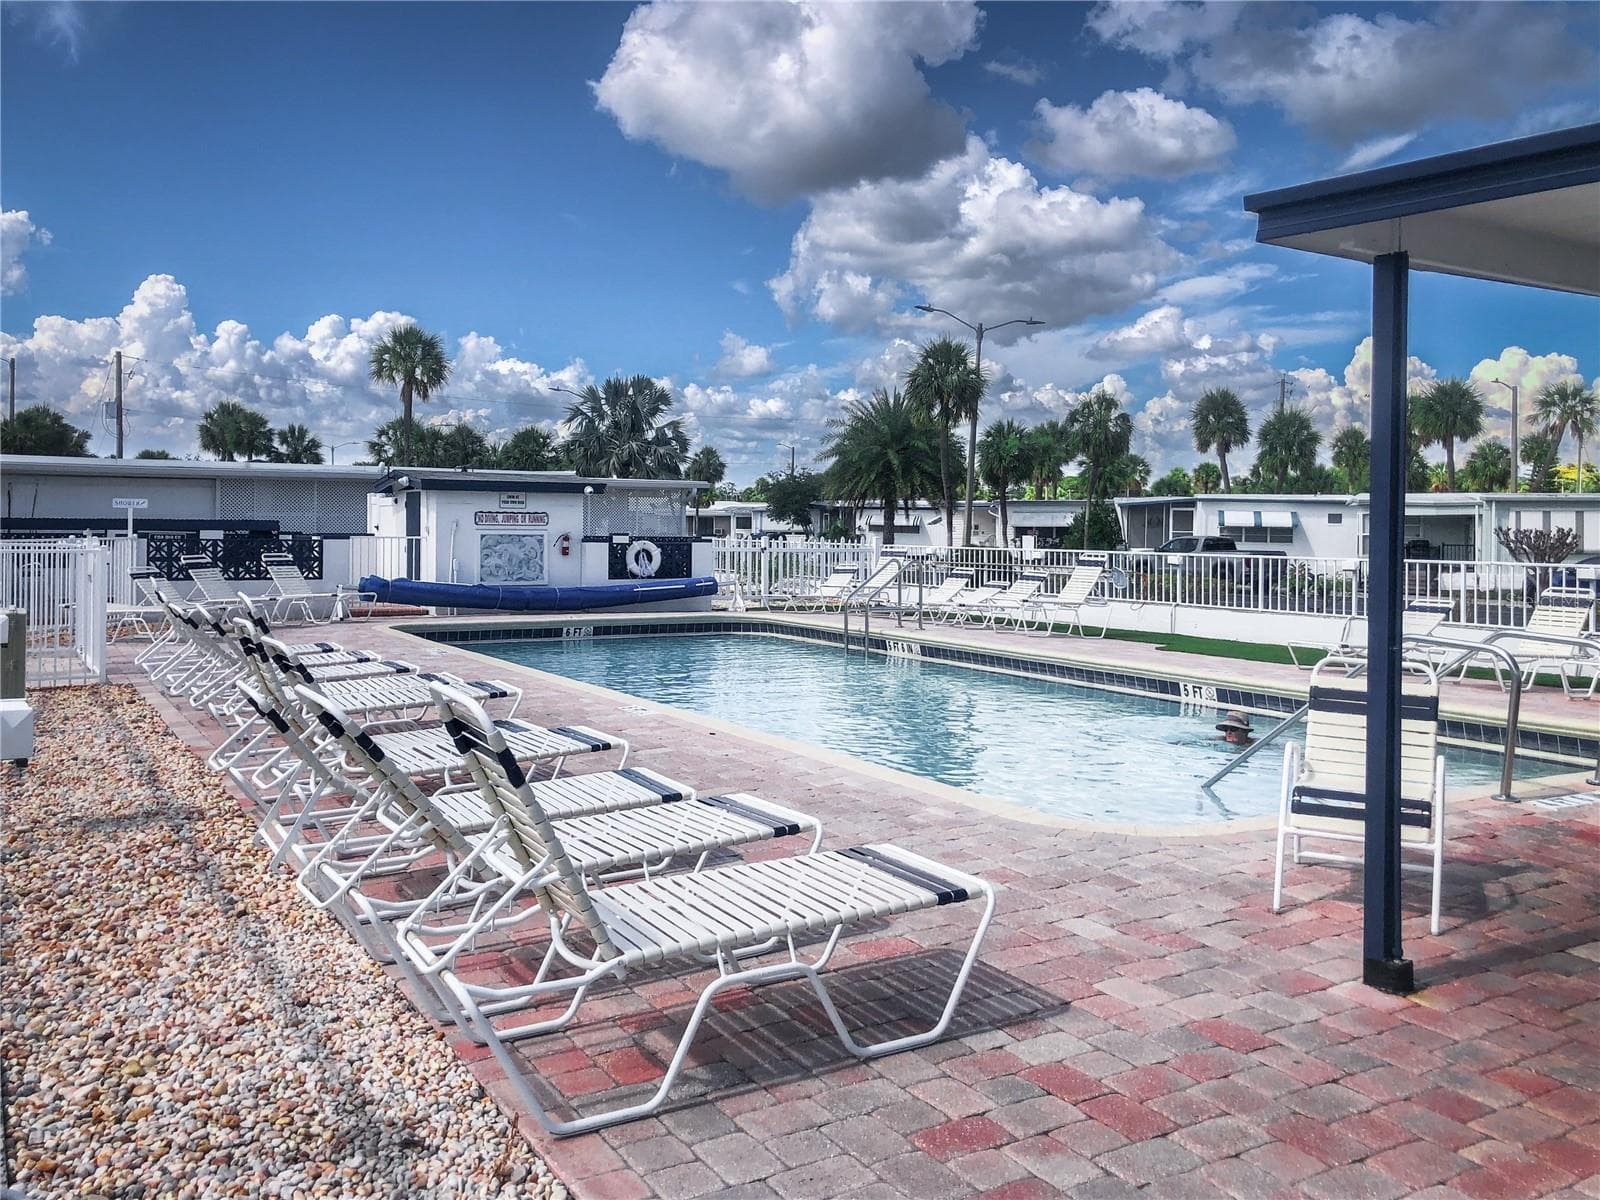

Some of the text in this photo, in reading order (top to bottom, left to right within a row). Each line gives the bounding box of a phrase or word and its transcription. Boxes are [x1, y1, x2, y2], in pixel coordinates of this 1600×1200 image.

[478, 514, 484, 523] NO
[501, 514, 519, 523] JUMPING
[520, 514, 527, 523] OR
[528, 514, 546, 523] RUNNING
[565, 627, 583, 637] 6 FT
[1183, 684, 1203, 699] 5 FT
